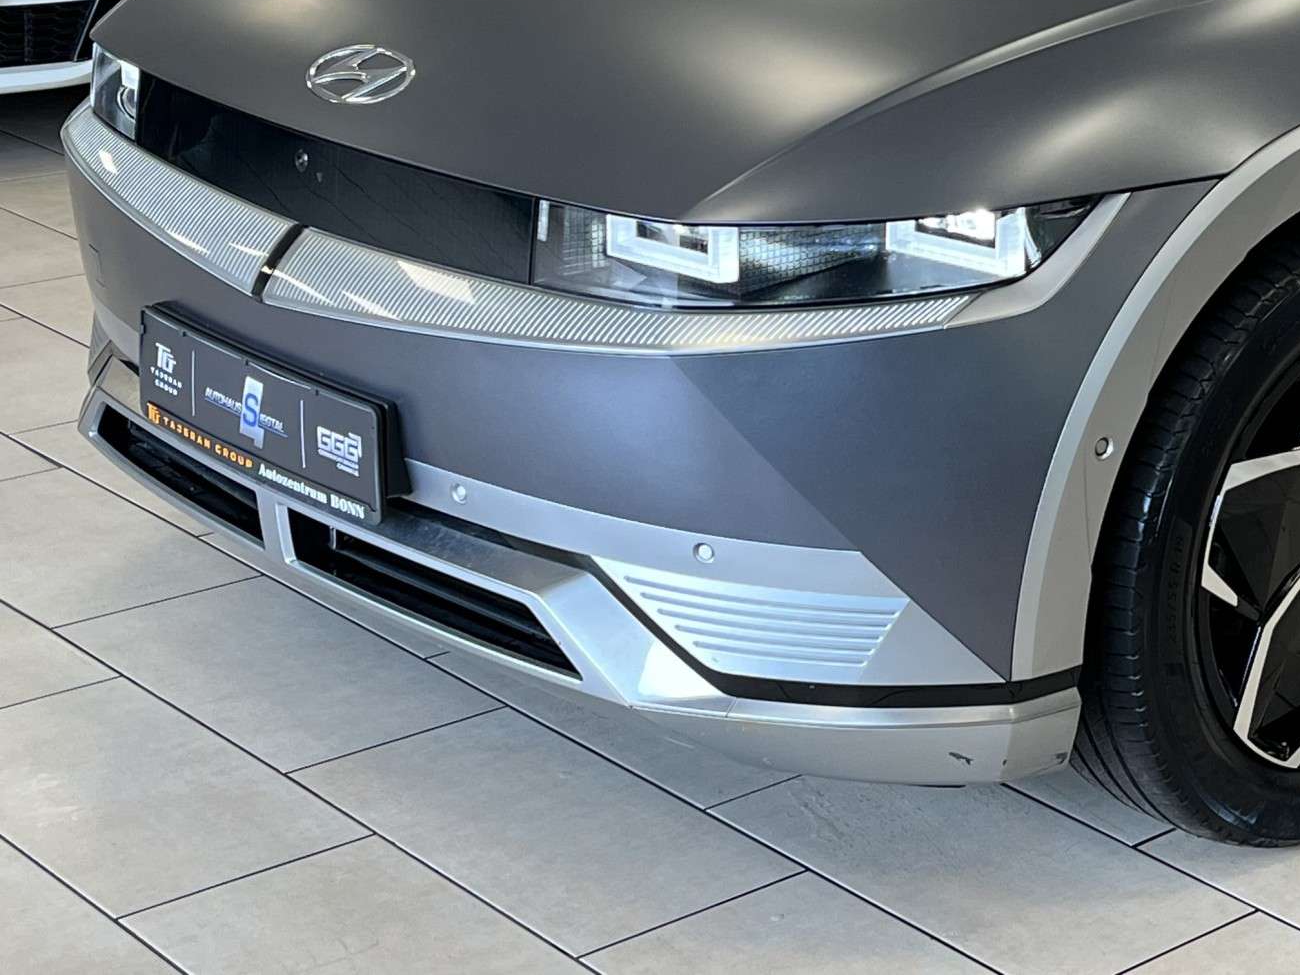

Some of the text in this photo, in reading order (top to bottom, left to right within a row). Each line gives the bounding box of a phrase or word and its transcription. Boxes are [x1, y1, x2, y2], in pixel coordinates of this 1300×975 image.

[205, 387, 242, 414] AUTOHAUS
[214, 444, 253, 468] GROUP
[258, 463, 328, 504] Autozentrum
[330, 494, 365, 519] BONN
